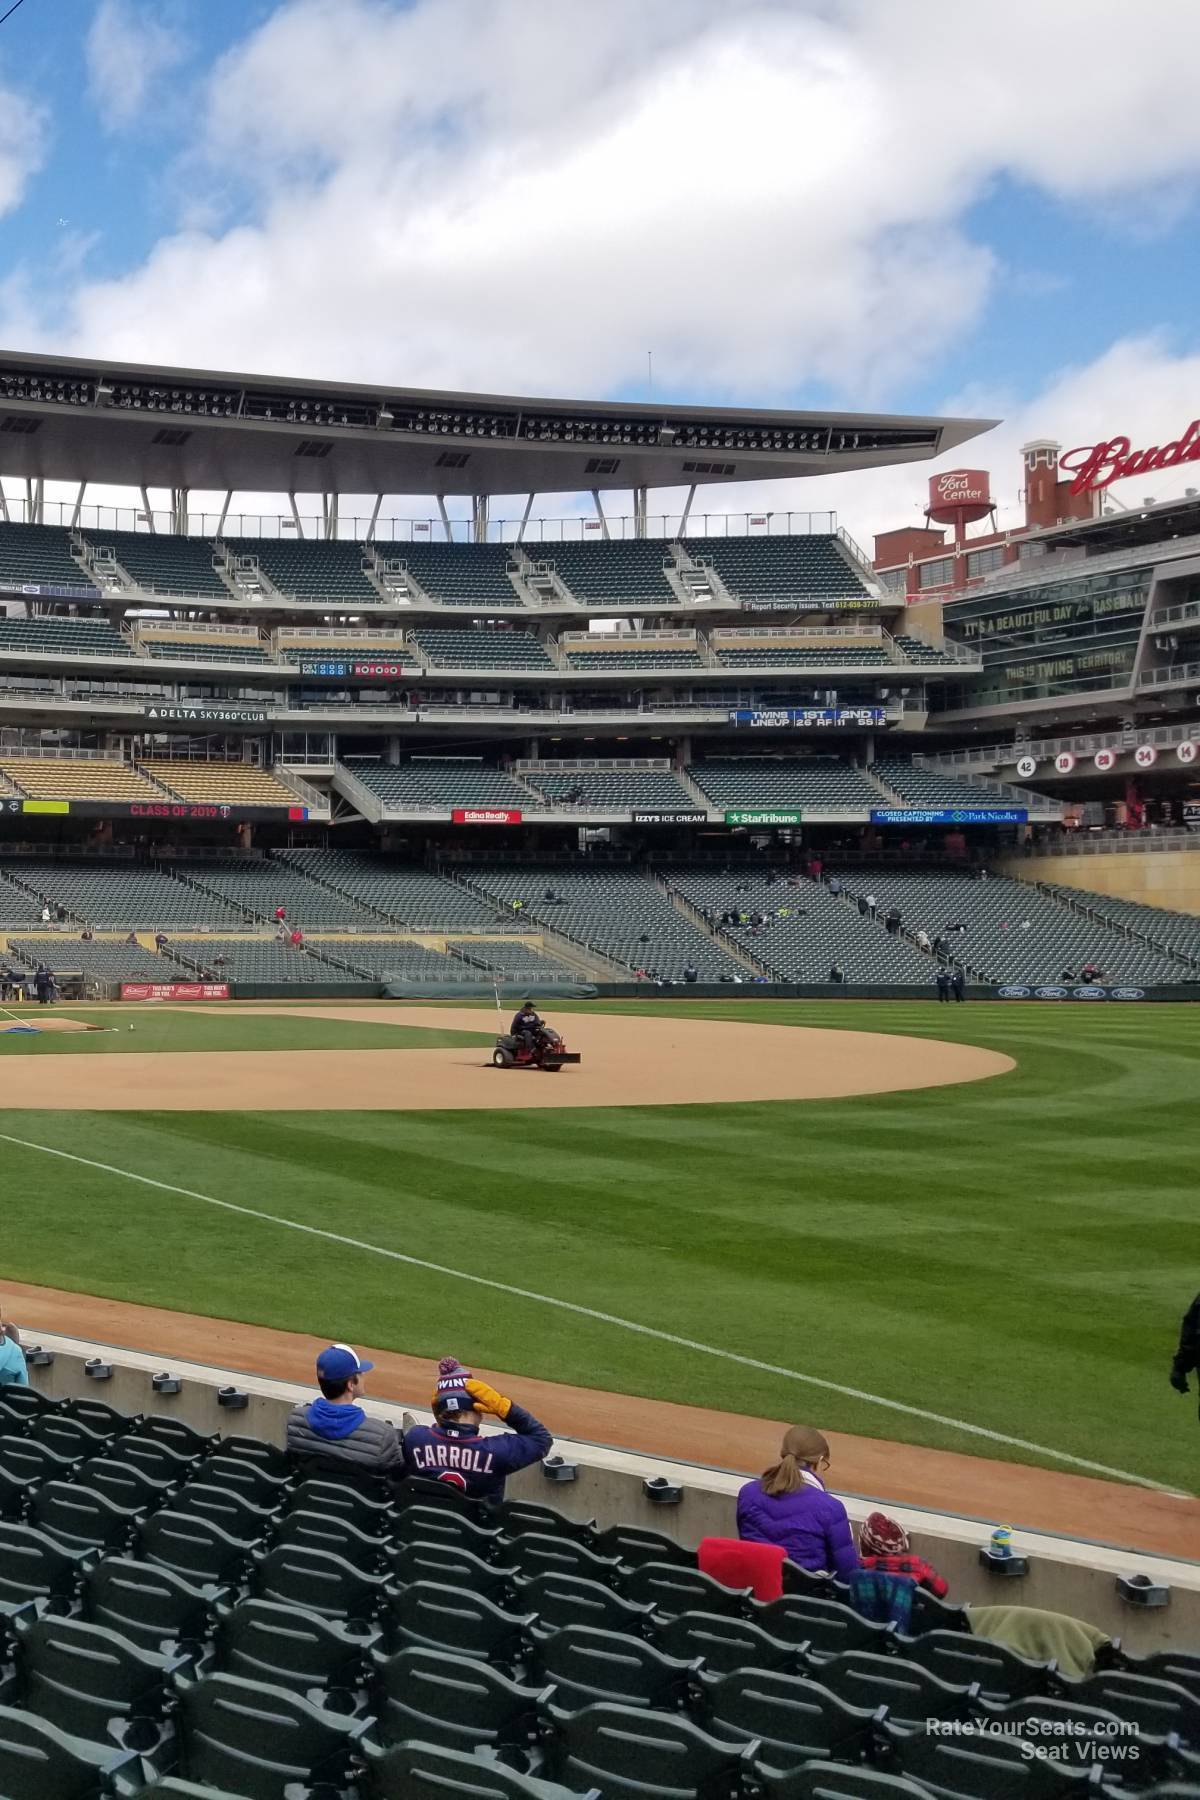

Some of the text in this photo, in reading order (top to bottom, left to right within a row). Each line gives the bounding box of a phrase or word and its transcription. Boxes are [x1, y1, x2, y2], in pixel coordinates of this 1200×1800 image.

[938, 473, 969, 492] Ford
[943, 488, 982, 500] Center
[964, 620, 985, 636] IT'S
[987, 619, 995, 632] A
[997, 609, 1050, 631] BEAUTIFUL
[1053, 605, 1072, 621] DAY
[1094, 592, 1146, 614] BASEBALL
[1038, 658, 1073, 678] TWINS
[1077, 651, 1127, 669] TERRITORY
[160, 709, 197, 719] DELTA
[752, 711, 789, 719] TWINS
[802, 711, 826, 719] 1ST
[840, 710, 872, 719] 2ND
[750, 719, 790, 727] LINEUP
[796, 719, 812, 727] 26
[817, 719, 833, 727] RF
[1138, 751, 1151, 762] 34
[1020, 762, 1032, 772] 42
[1059, 758, 1069, 768] 10
[130, 804, 169, 816] CLASS
[172, 805, 187, 817] OF
[191, 806, 217, 817] 2019
[464, 811, 484, 819] Edina
[968, 811, 1017, 820] Park Nicollet
[741, 813, 797, 823] StarTribune
[1005, 987, 1023, 996] Ford
[1041, 988, 1060, 997] Ford
[1079, 989, 1099, 997] Ford
[1117, 989, 1138, 998] Ford
[413, 1445, 494, 1474] CARROLL
